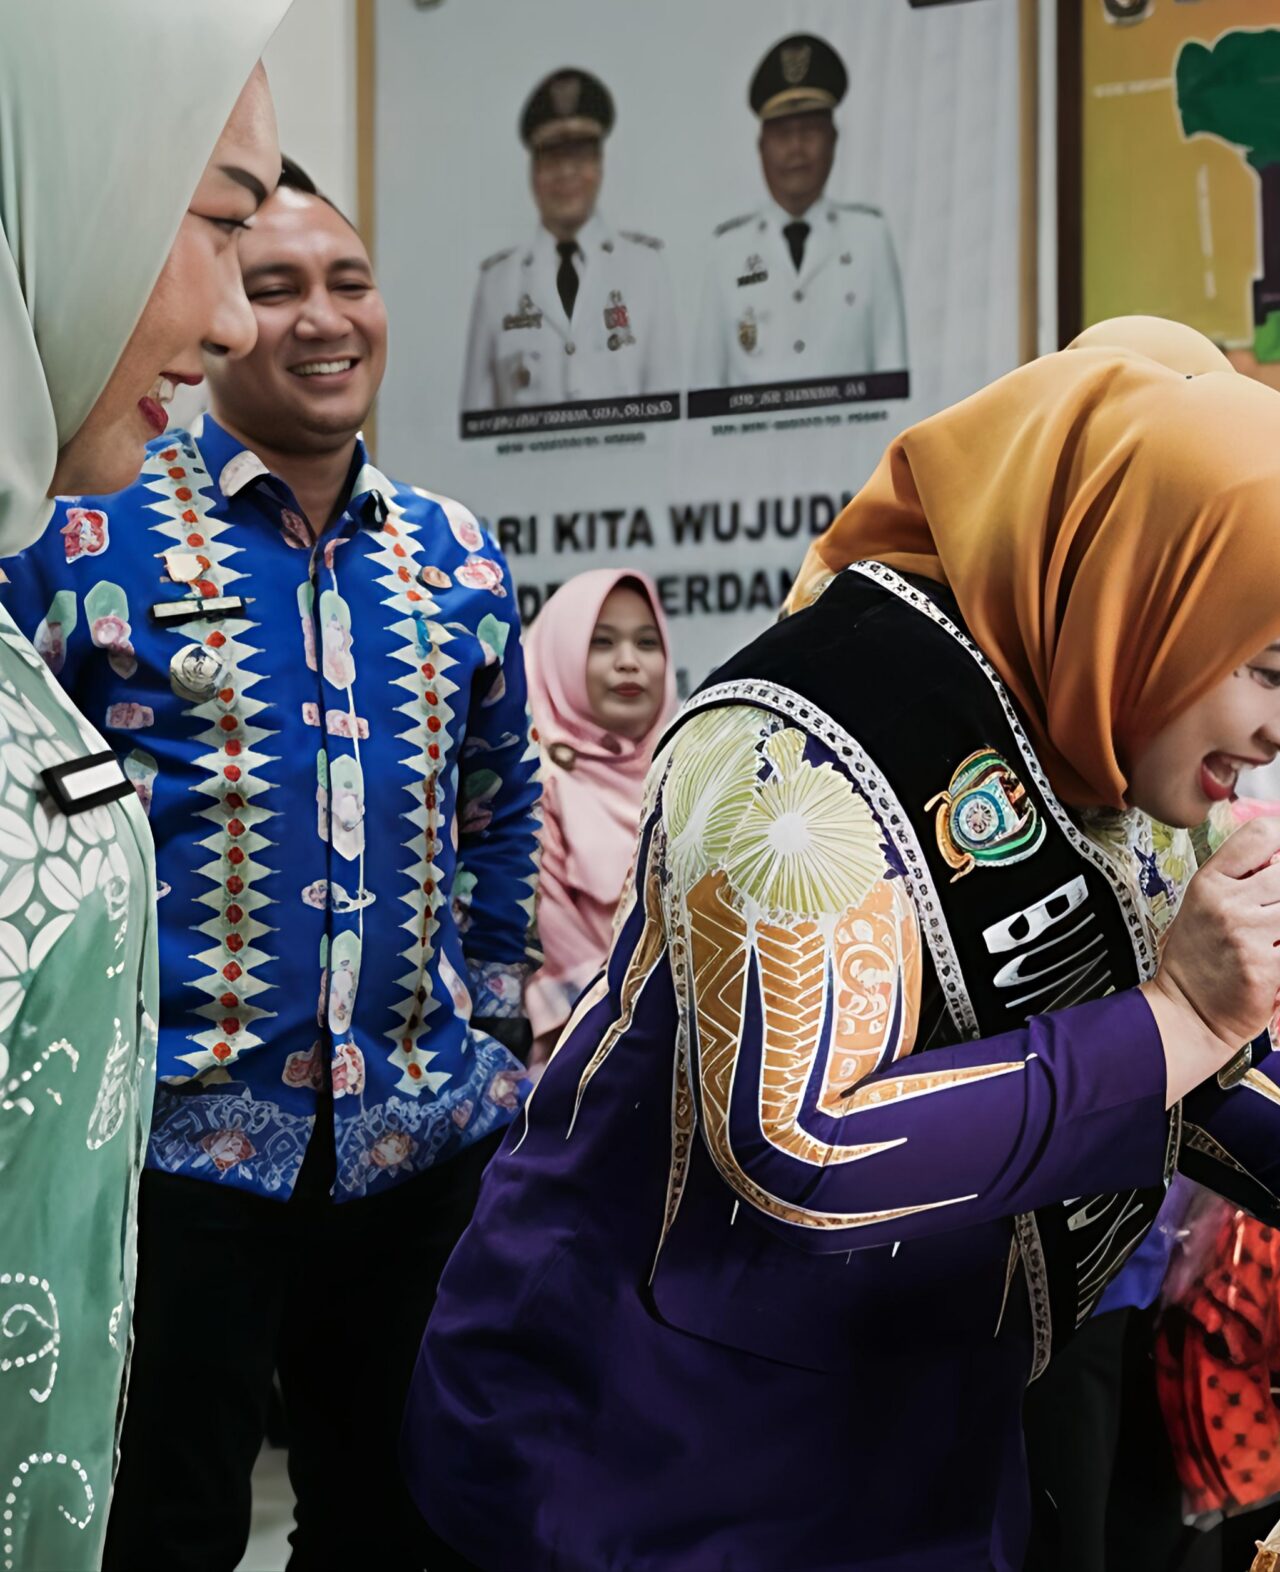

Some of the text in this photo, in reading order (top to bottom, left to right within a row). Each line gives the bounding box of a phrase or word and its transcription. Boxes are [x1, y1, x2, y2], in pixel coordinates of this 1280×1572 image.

[480, 490, 852, 555] RI KITA WUJUD
